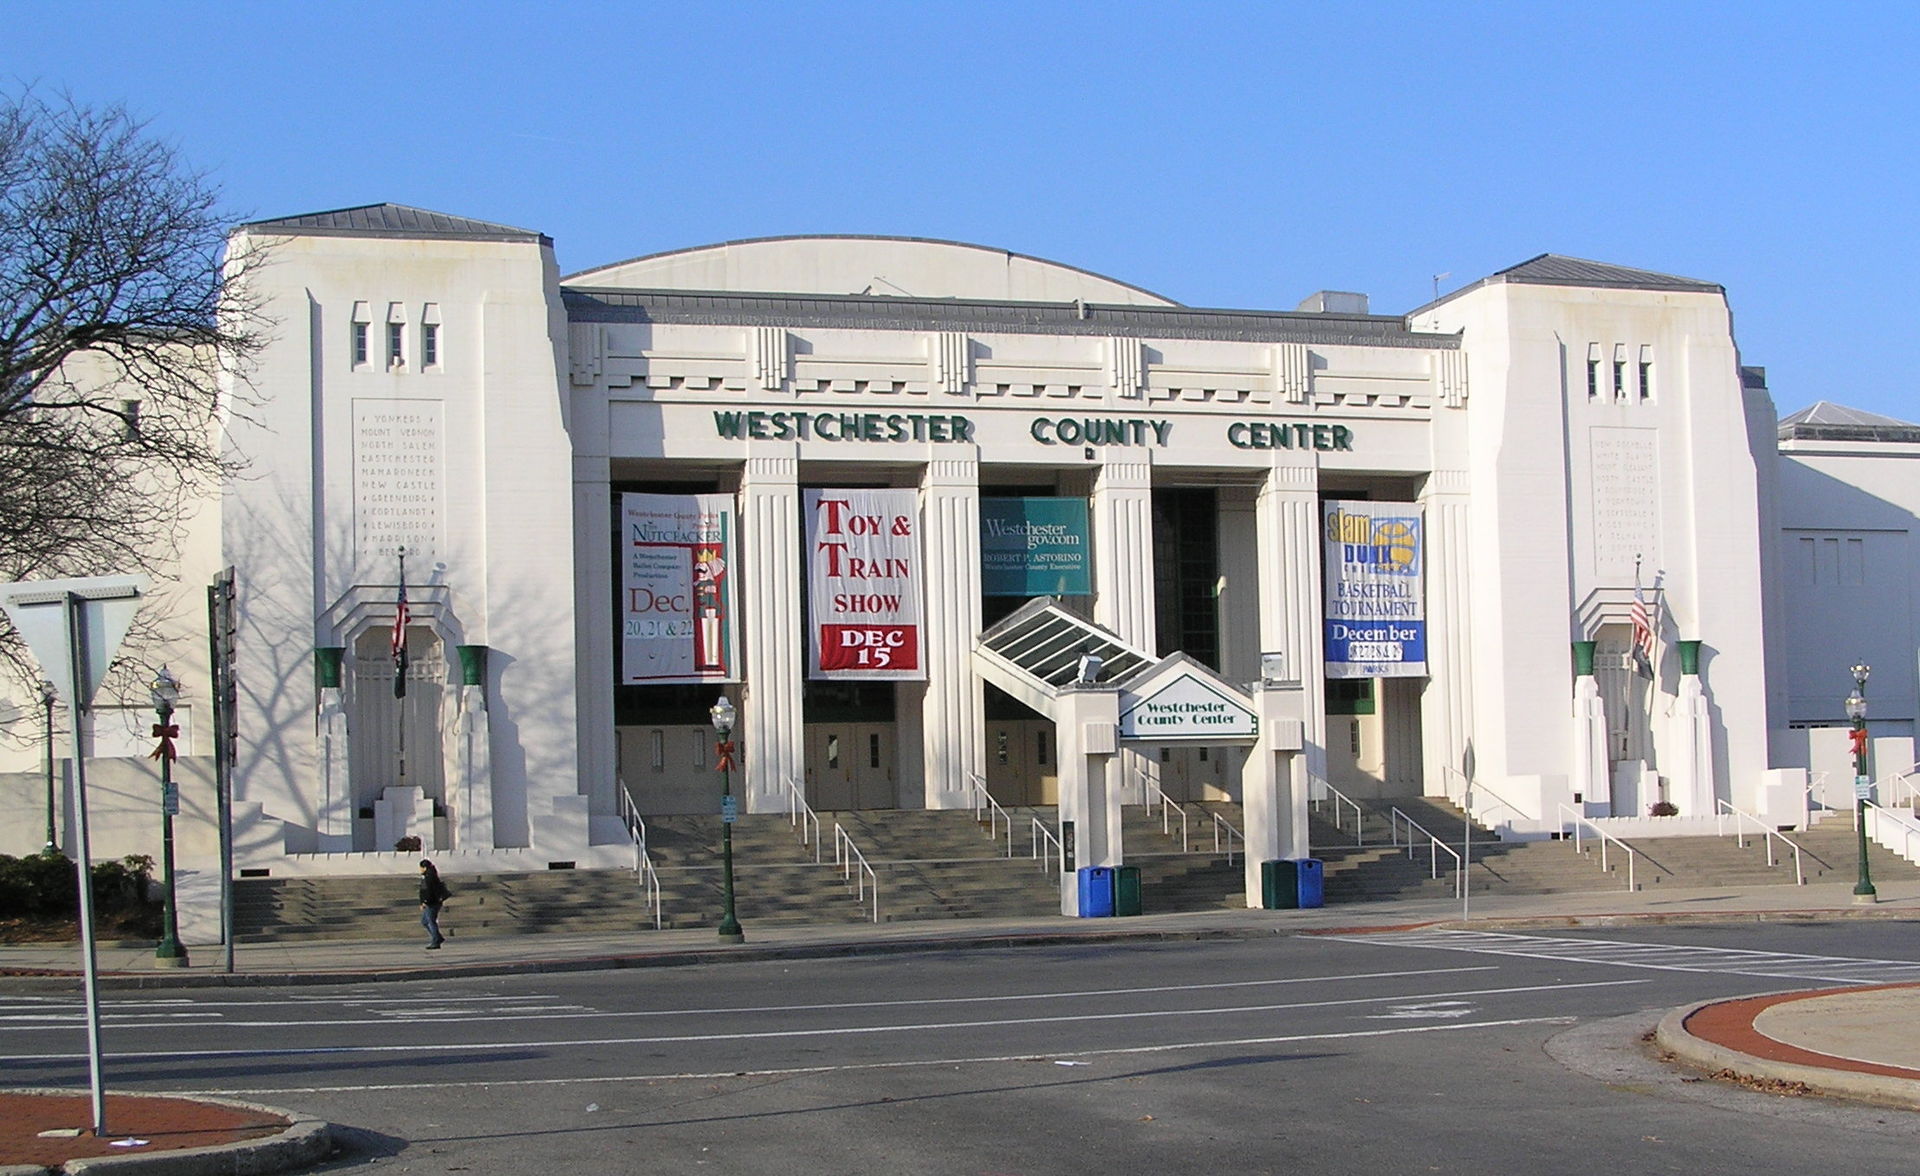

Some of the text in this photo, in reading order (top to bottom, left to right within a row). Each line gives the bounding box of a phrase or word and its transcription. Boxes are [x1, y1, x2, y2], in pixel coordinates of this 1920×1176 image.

[374, 416, 422, 424] YONKERS
[361, 429, 436, 437] MOUNT VERNON
[713, 411, 1350, 450] WESTCHESTER COUNTY CENTER
[402, 442, 436, 450] SALEM
[361, 455, 436, 463] EASTCHESTER
[361, 468, 436, 477] MAMARONECK
[362, 481, 436, 490] NEW CASTLE
[371, 508, 427, 516] CORTLANDT
[816, 500, 912, 536] TOY &
[371, 521, 428, 530] LEWISBORO
[986, 519, 1067, 537] Westchester
[1027, 534, 1080, 550] gov.com
[818, 542, 909, 580] TRAIN
[1033, 553, 1082, 562] ASTORINO
[1338, 583, 1412, 598] BASKETBALL
[628, 587, 690, 614] Dec.
[834, 594, 902, 613] SHOW
[1332, 600, 1417, 616] TOURNAMENT
[648, 621, 661, 635] 21
[666, 622, 676, 636] &
[680, 621, 693, 636] 22
[1332, 624, 1417, 640] December
[840, 630, 904, 647] DEC
[857, 648, 891, 667] 15
[1147, 702, 1226, 712] Westchester
[1138, 715, 1236, 725] County Center
